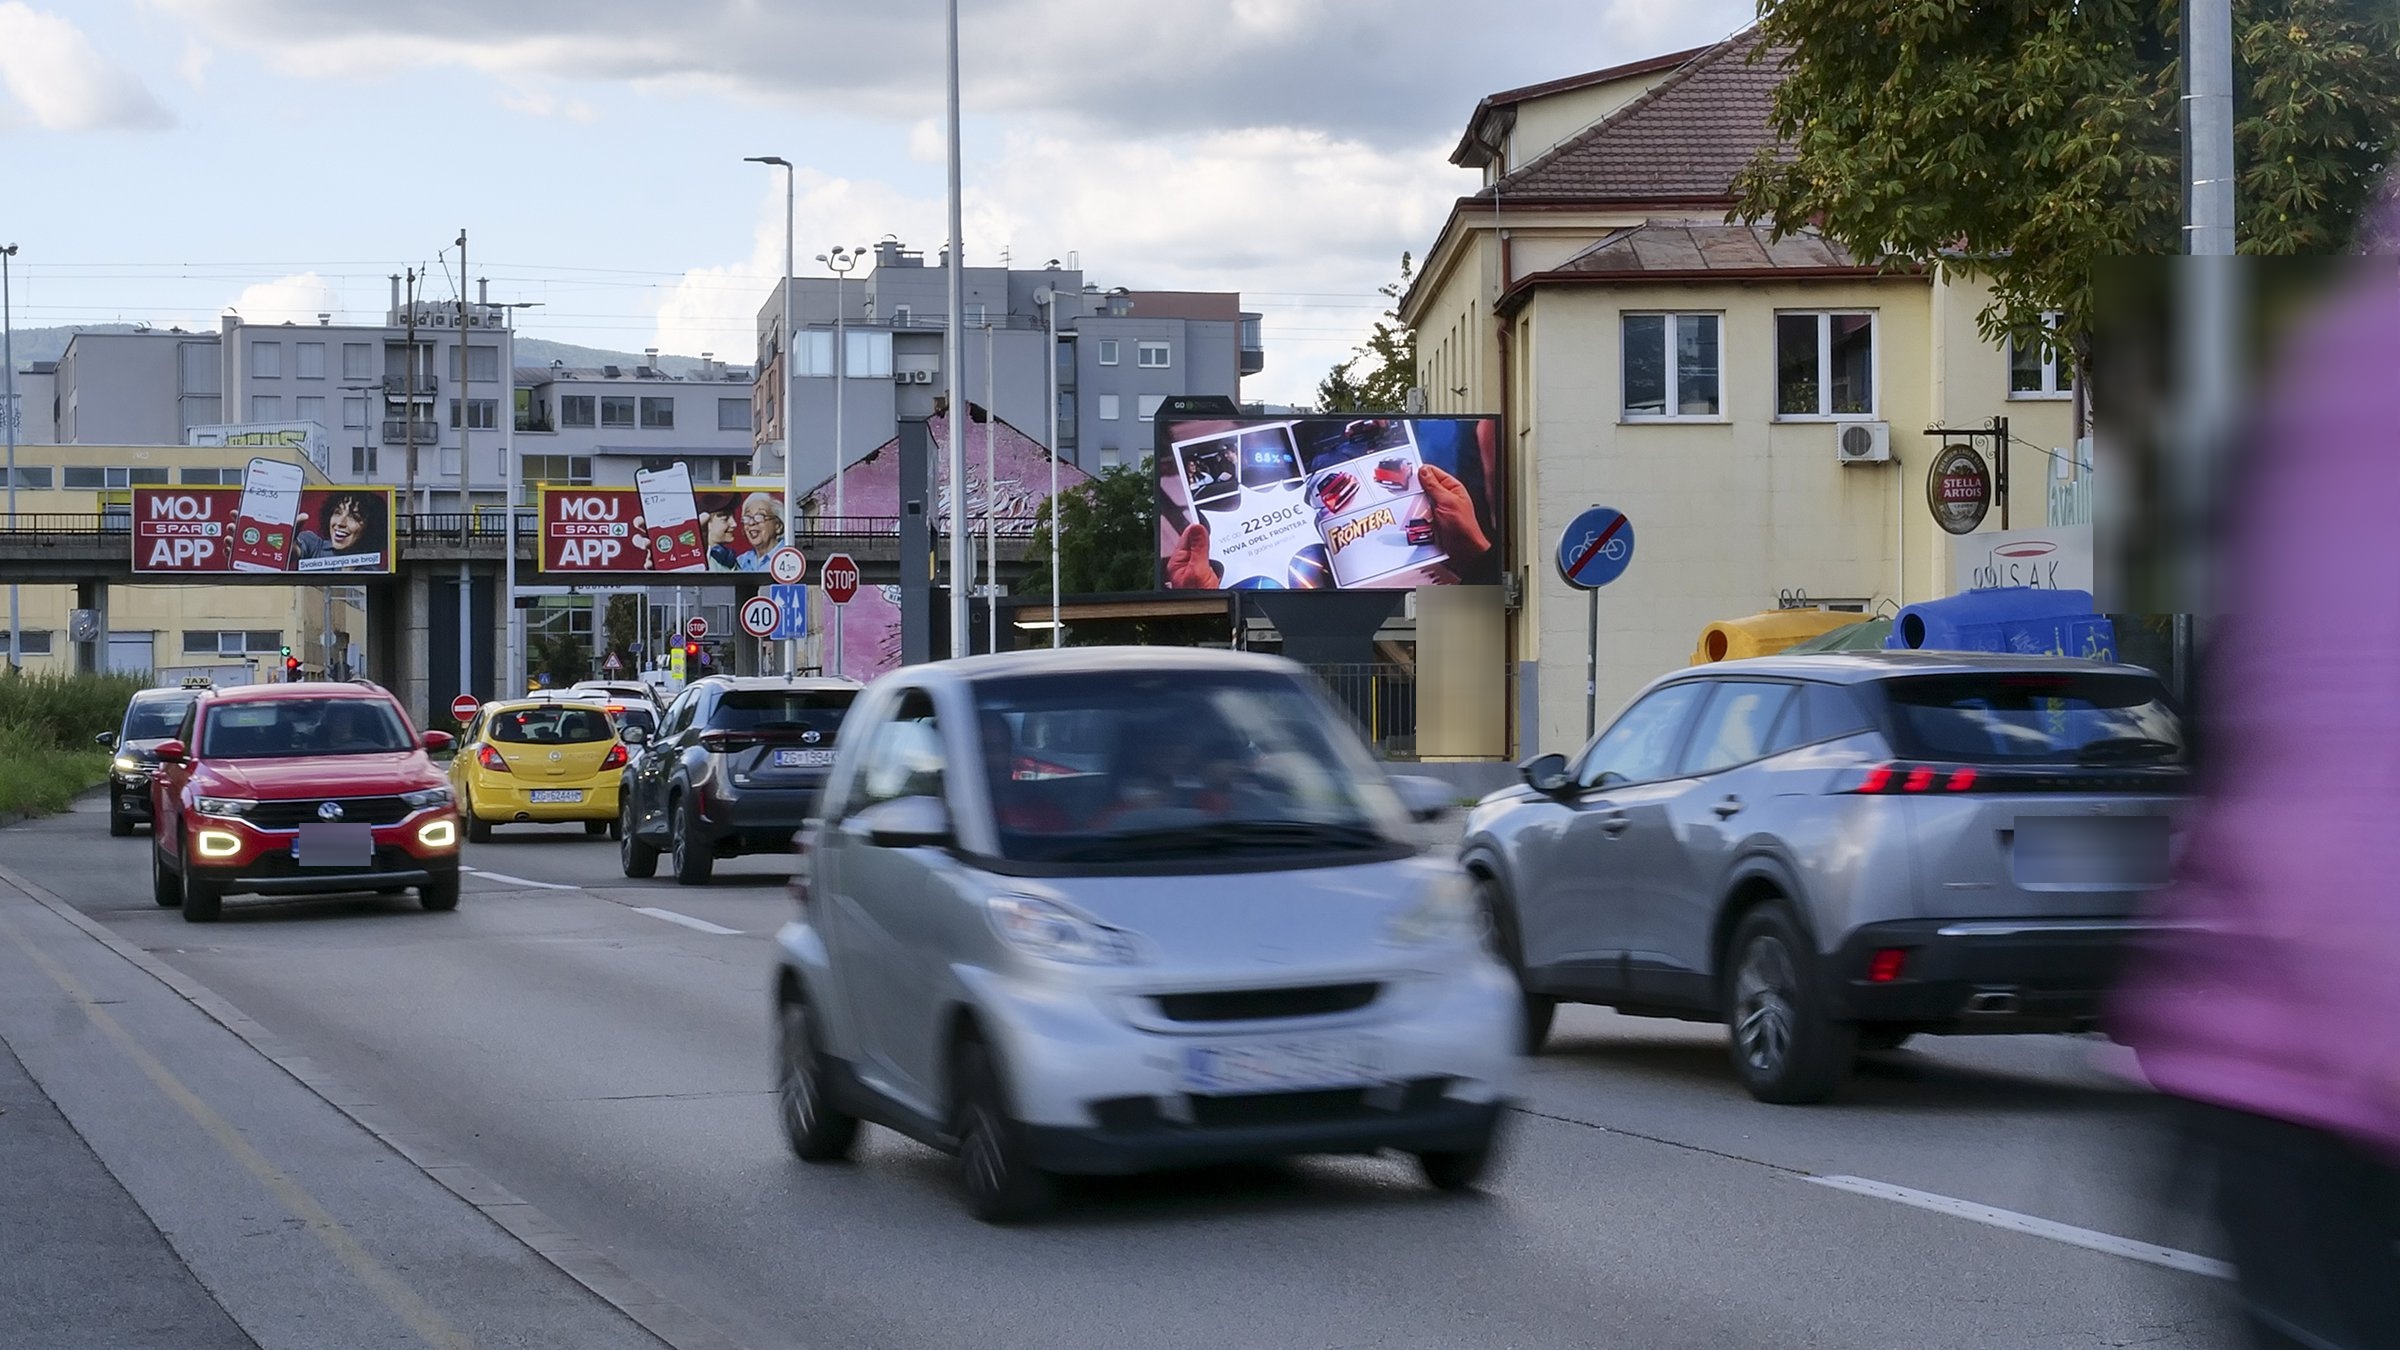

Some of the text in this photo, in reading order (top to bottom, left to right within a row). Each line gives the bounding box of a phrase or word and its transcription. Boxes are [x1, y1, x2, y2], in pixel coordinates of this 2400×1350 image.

[1943, 478, 1982, 488] STELLA
[1943, 487, 1982, 498] ARTOIS
[151, 496, 212, 520] MOJ
[560, 497, 619, 521] MOJ
[156, 524, 202, 534] SPAR
[565, 525, 609, 534] SPAR
[1222, 519, 1307, 555] NOVA OPEL FRONTERA
[1328, 507, 1397, 556] FRONTERA
[149, 539, 214, 567] APP
[558, 540, 622, 567] APP
[826, 569, 856, 590] STOP
[749, 606, 772, 627] 40
[689, 623, 706, 632] STOP
